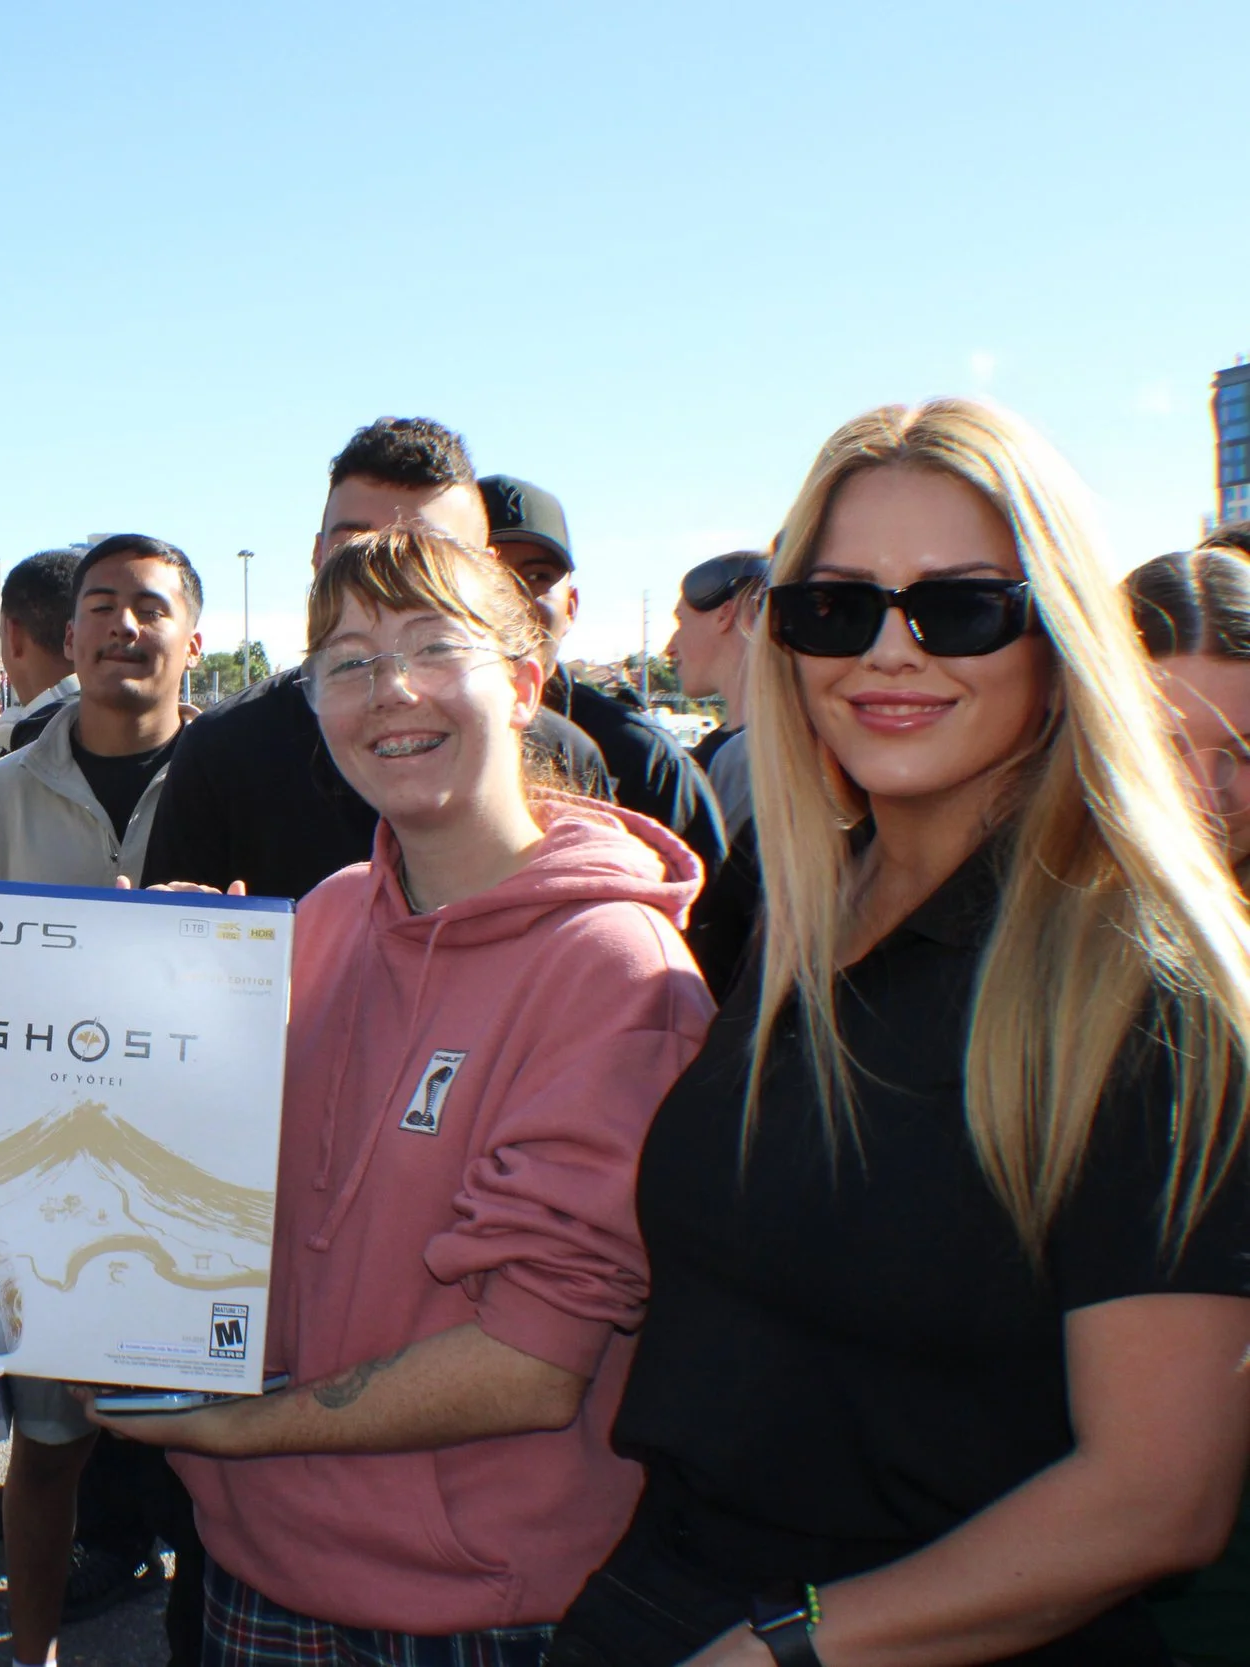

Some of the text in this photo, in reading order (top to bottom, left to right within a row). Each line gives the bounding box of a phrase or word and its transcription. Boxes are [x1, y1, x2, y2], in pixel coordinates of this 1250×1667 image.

[192, 924, 204, 934] TB
[250, 929, 274, 938] HDR
[228, 976, 273, 986] EDITION
[50, 1072, 68, 1083] OF
[214, 1319, 243, 1348] M
[210, 1350, 244, 1358] ESRB
